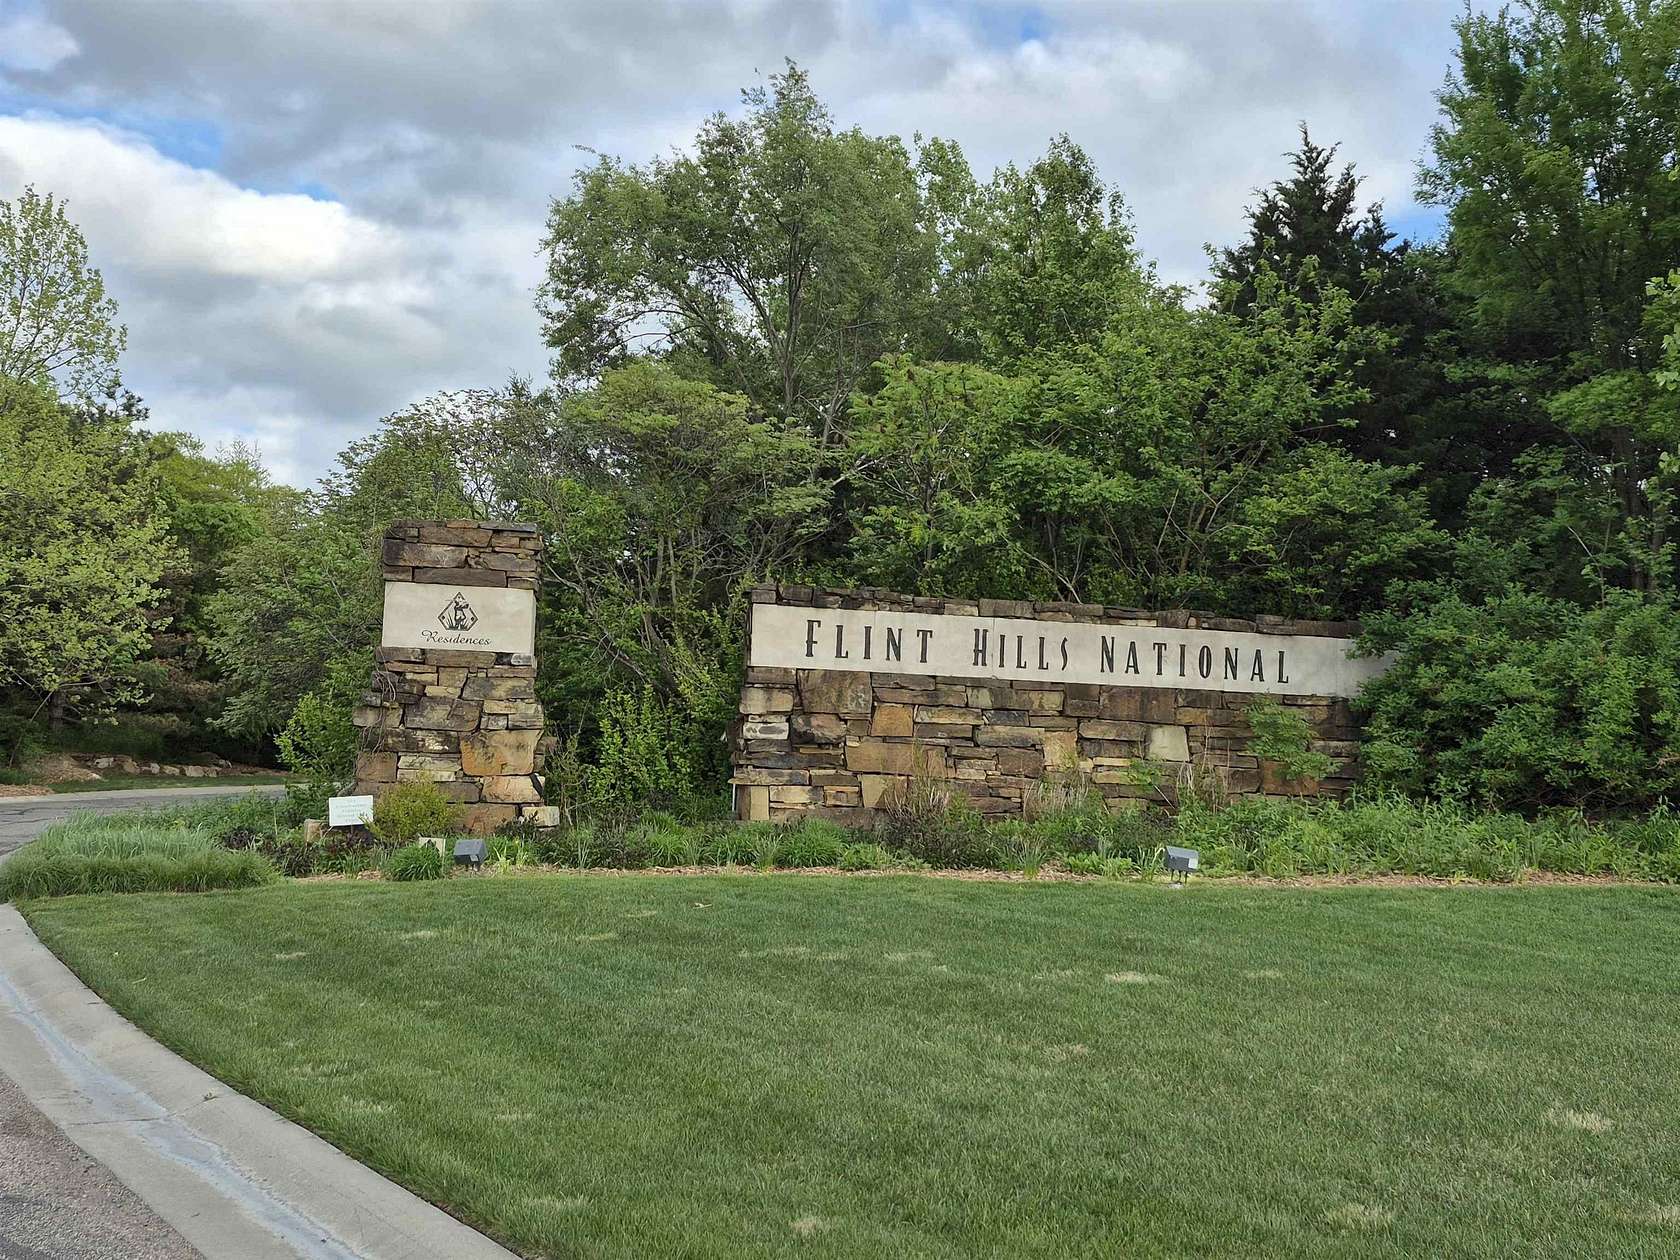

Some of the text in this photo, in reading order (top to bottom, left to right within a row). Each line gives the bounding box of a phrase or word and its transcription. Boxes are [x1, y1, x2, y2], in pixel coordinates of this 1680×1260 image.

[421, 630, 491, 645] Residences
[805, 619, 1289, 684] FLINT HILLS NATIONAL
